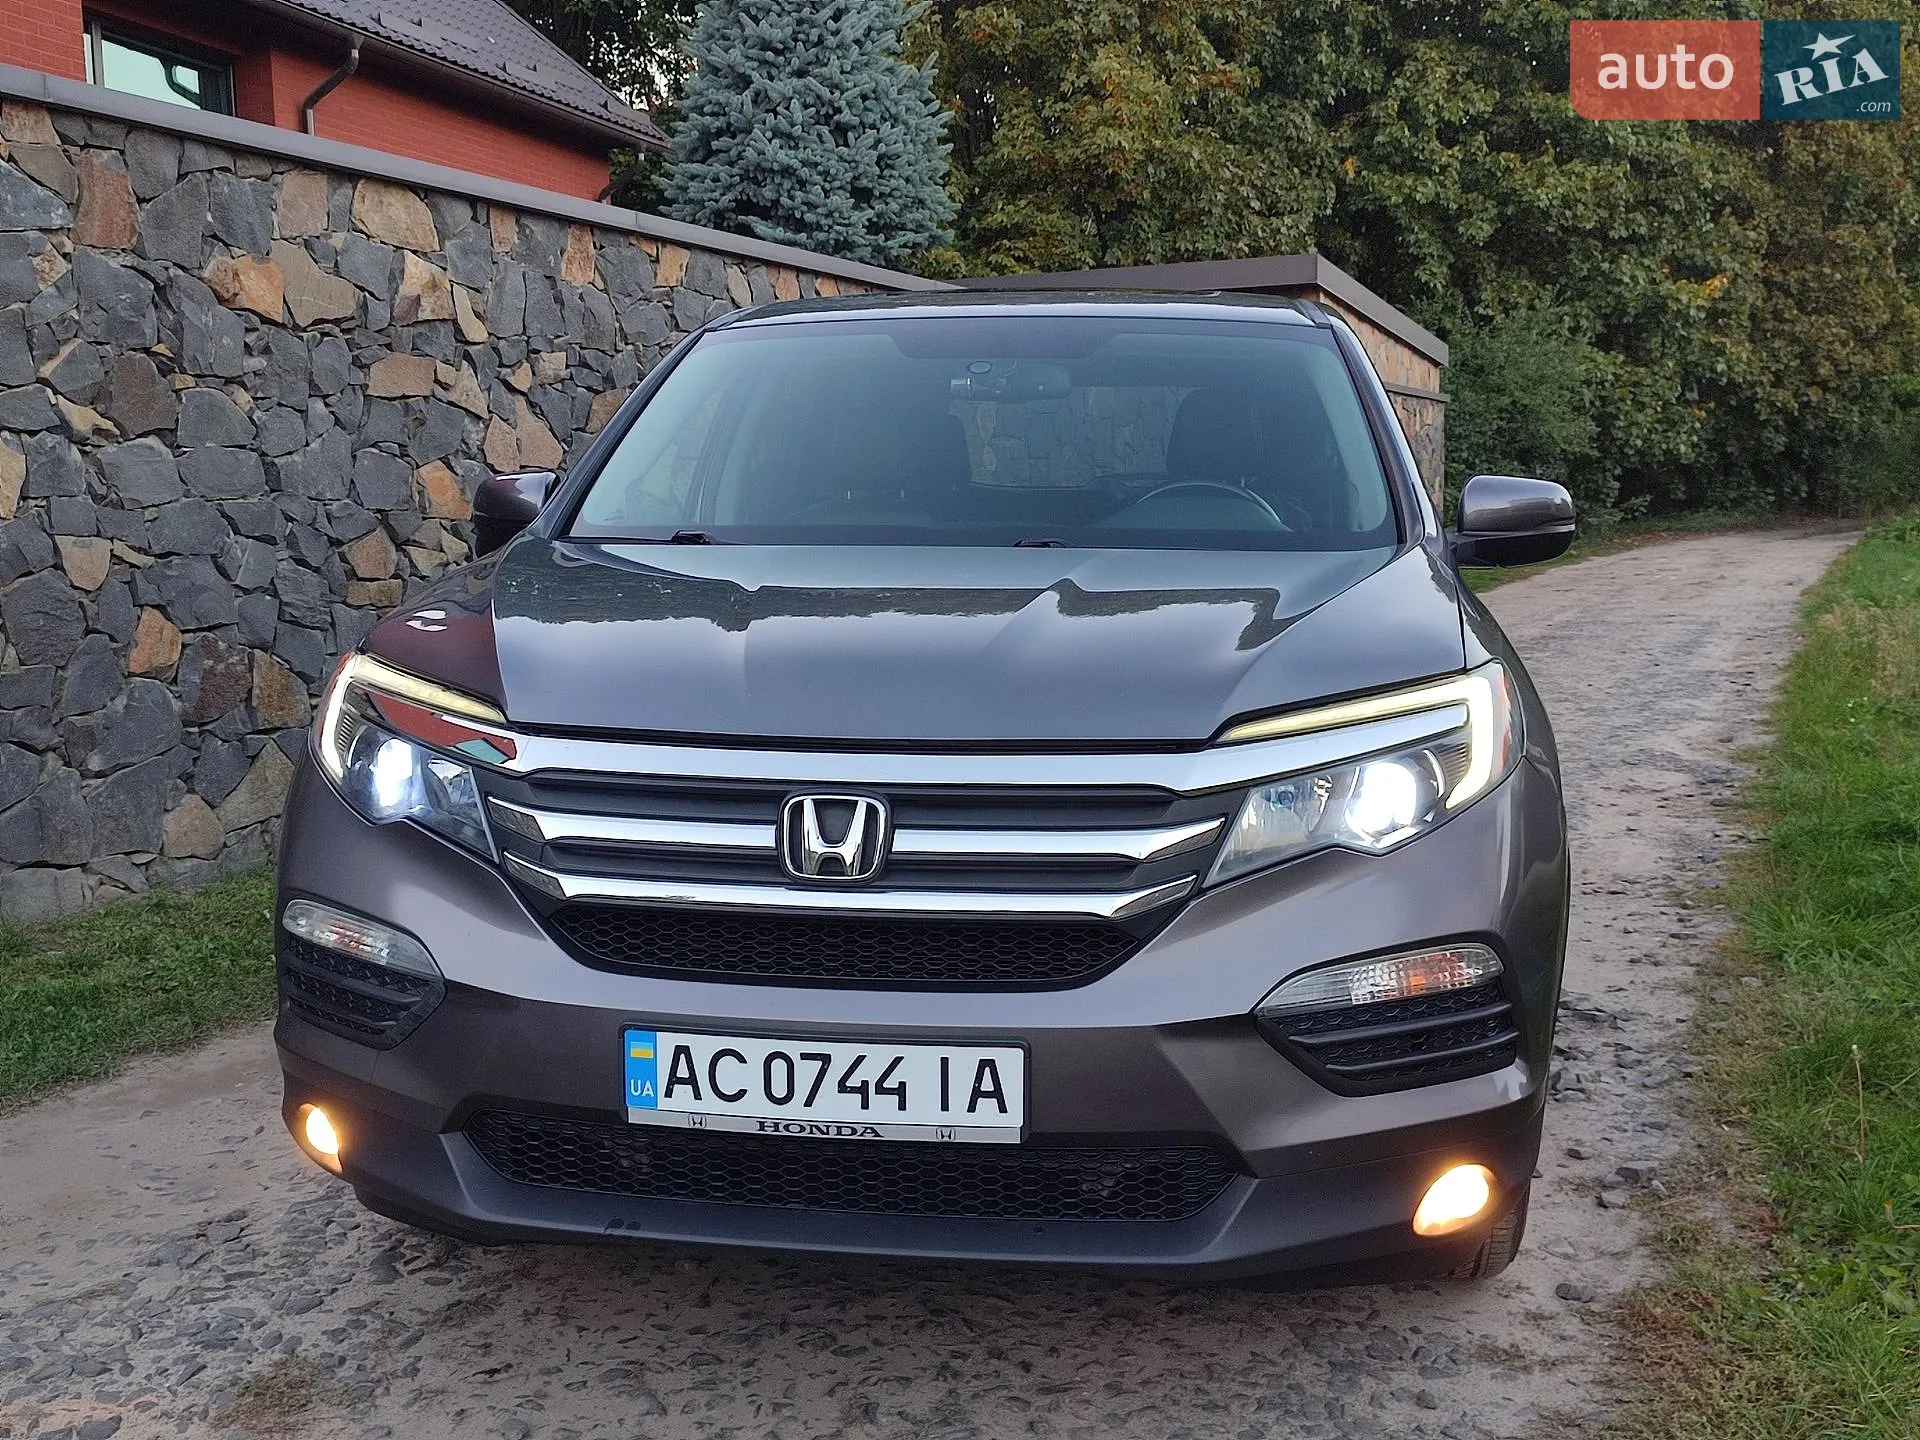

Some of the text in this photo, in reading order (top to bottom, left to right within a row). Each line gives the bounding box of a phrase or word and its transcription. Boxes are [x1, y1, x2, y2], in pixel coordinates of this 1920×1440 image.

[631, 1078, 655, 1098] UA
[664, 1044, 1008, 1114] AC 0744 IA
[755, 1119, 885, 1138] HONDA
